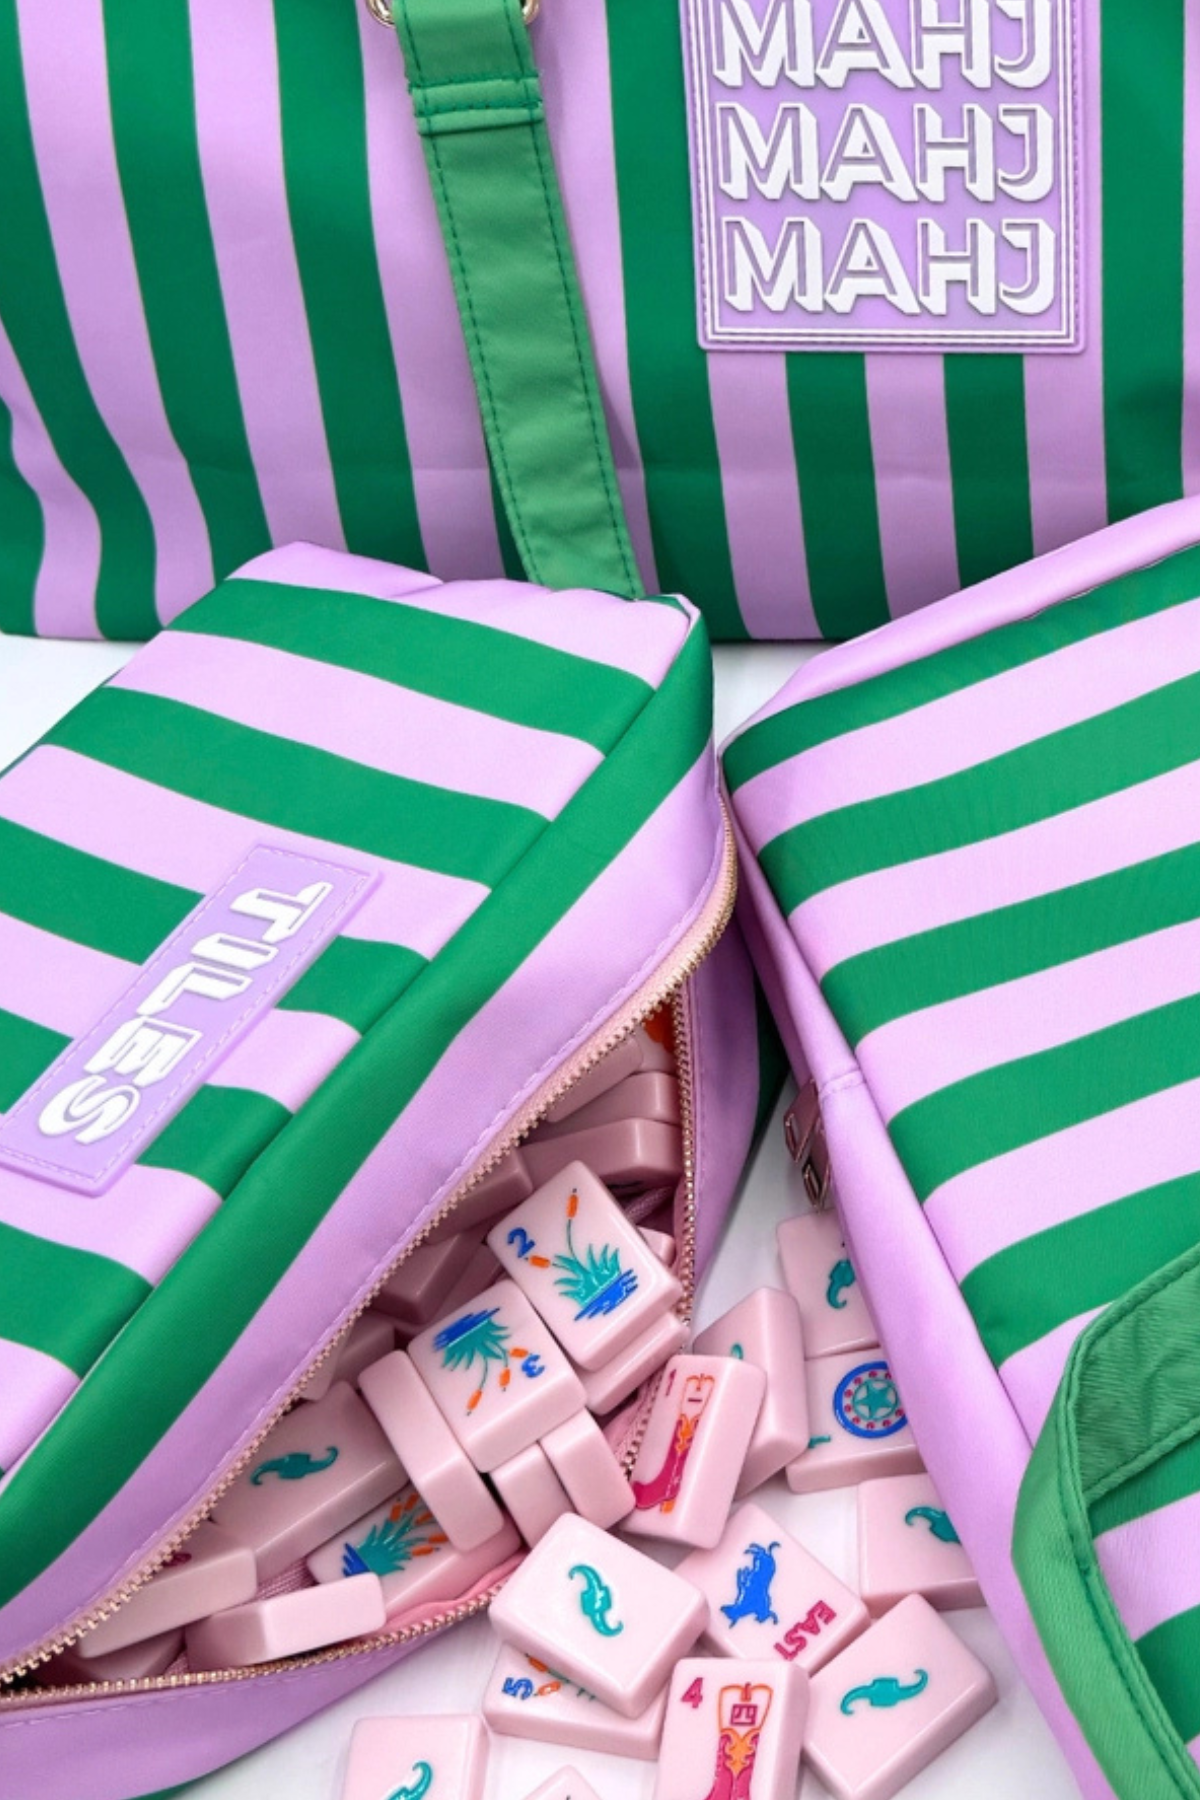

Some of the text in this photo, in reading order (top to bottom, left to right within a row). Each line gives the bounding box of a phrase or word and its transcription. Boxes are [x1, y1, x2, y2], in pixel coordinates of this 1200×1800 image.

[713, 0, 1052, 88] MAHJ
[716, 102, 1053, 202] MAHJ
[721, 216, 1056, 315] MAHJ
[38, 881, 333, 1144] TILES
[507, 1227, 535, 1258] 2
[521, 1354, 545, 1378] 3
[665, 1369, 677, 1397] 1
[773, 1600, 837, 1661] EAST
[502, 1677, 533, 1701] 5
[681, 1677, 704, 1709] 4
